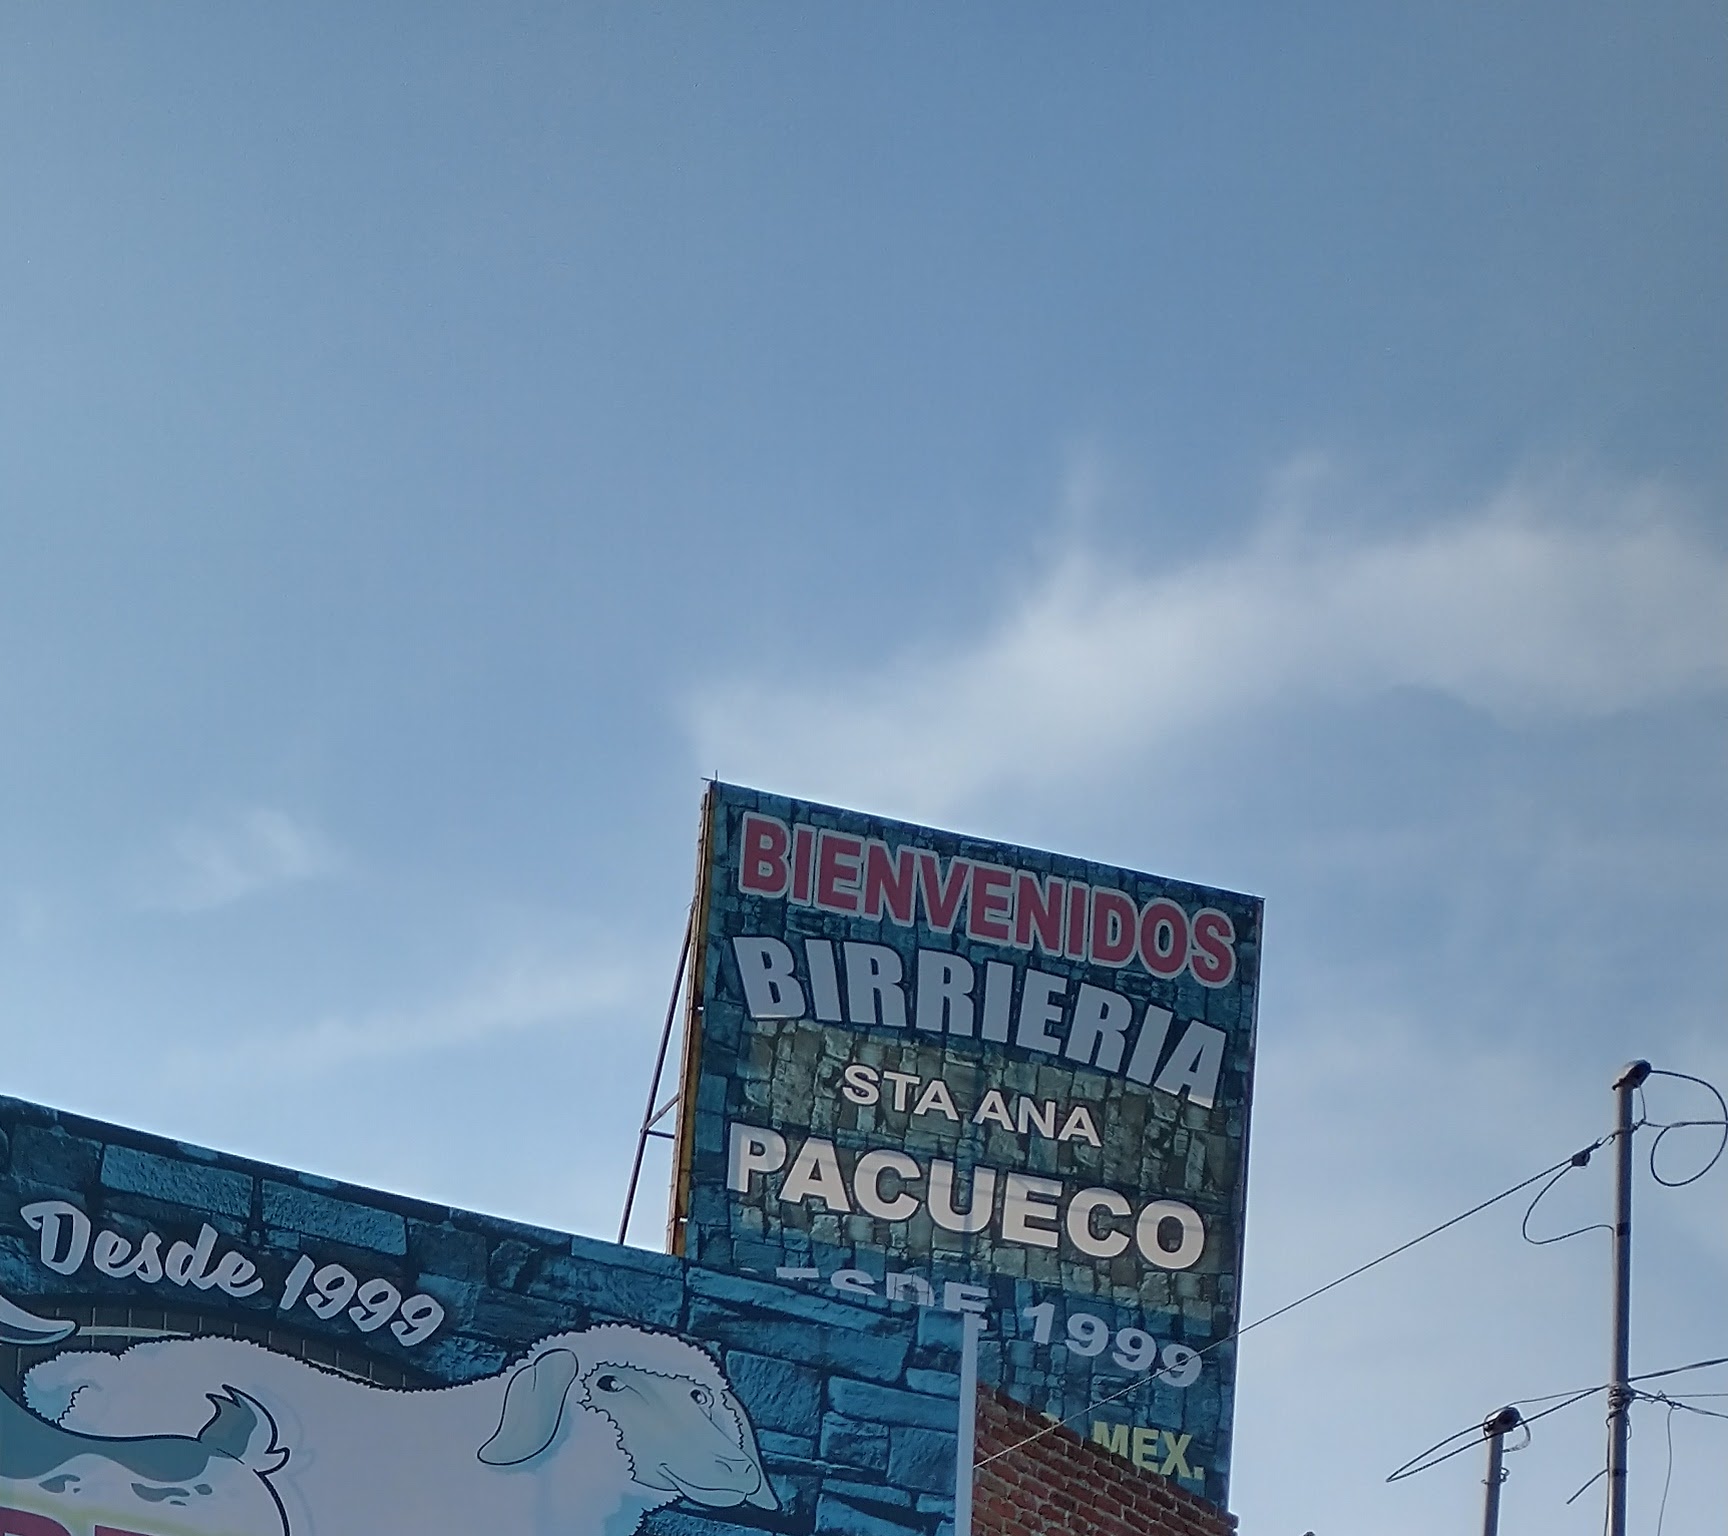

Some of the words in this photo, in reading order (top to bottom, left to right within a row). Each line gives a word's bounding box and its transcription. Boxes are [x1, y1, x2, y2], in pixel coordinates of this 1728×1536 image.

[738, 811, 1237, 990] BIENVENIDOS
[733, 935, 1226, 1109] BIRRIERIA
[842, 1063, 961, 1121] STA
[972, 1090, 1102, 1148] ANA
[725, 1123, 1206, 1270] PACUECO
[20, 1200, 264, 1298] Desde
[278, 1254, 446, 1348] 1999
[1022, 1301, 1204, 1388] 1999
